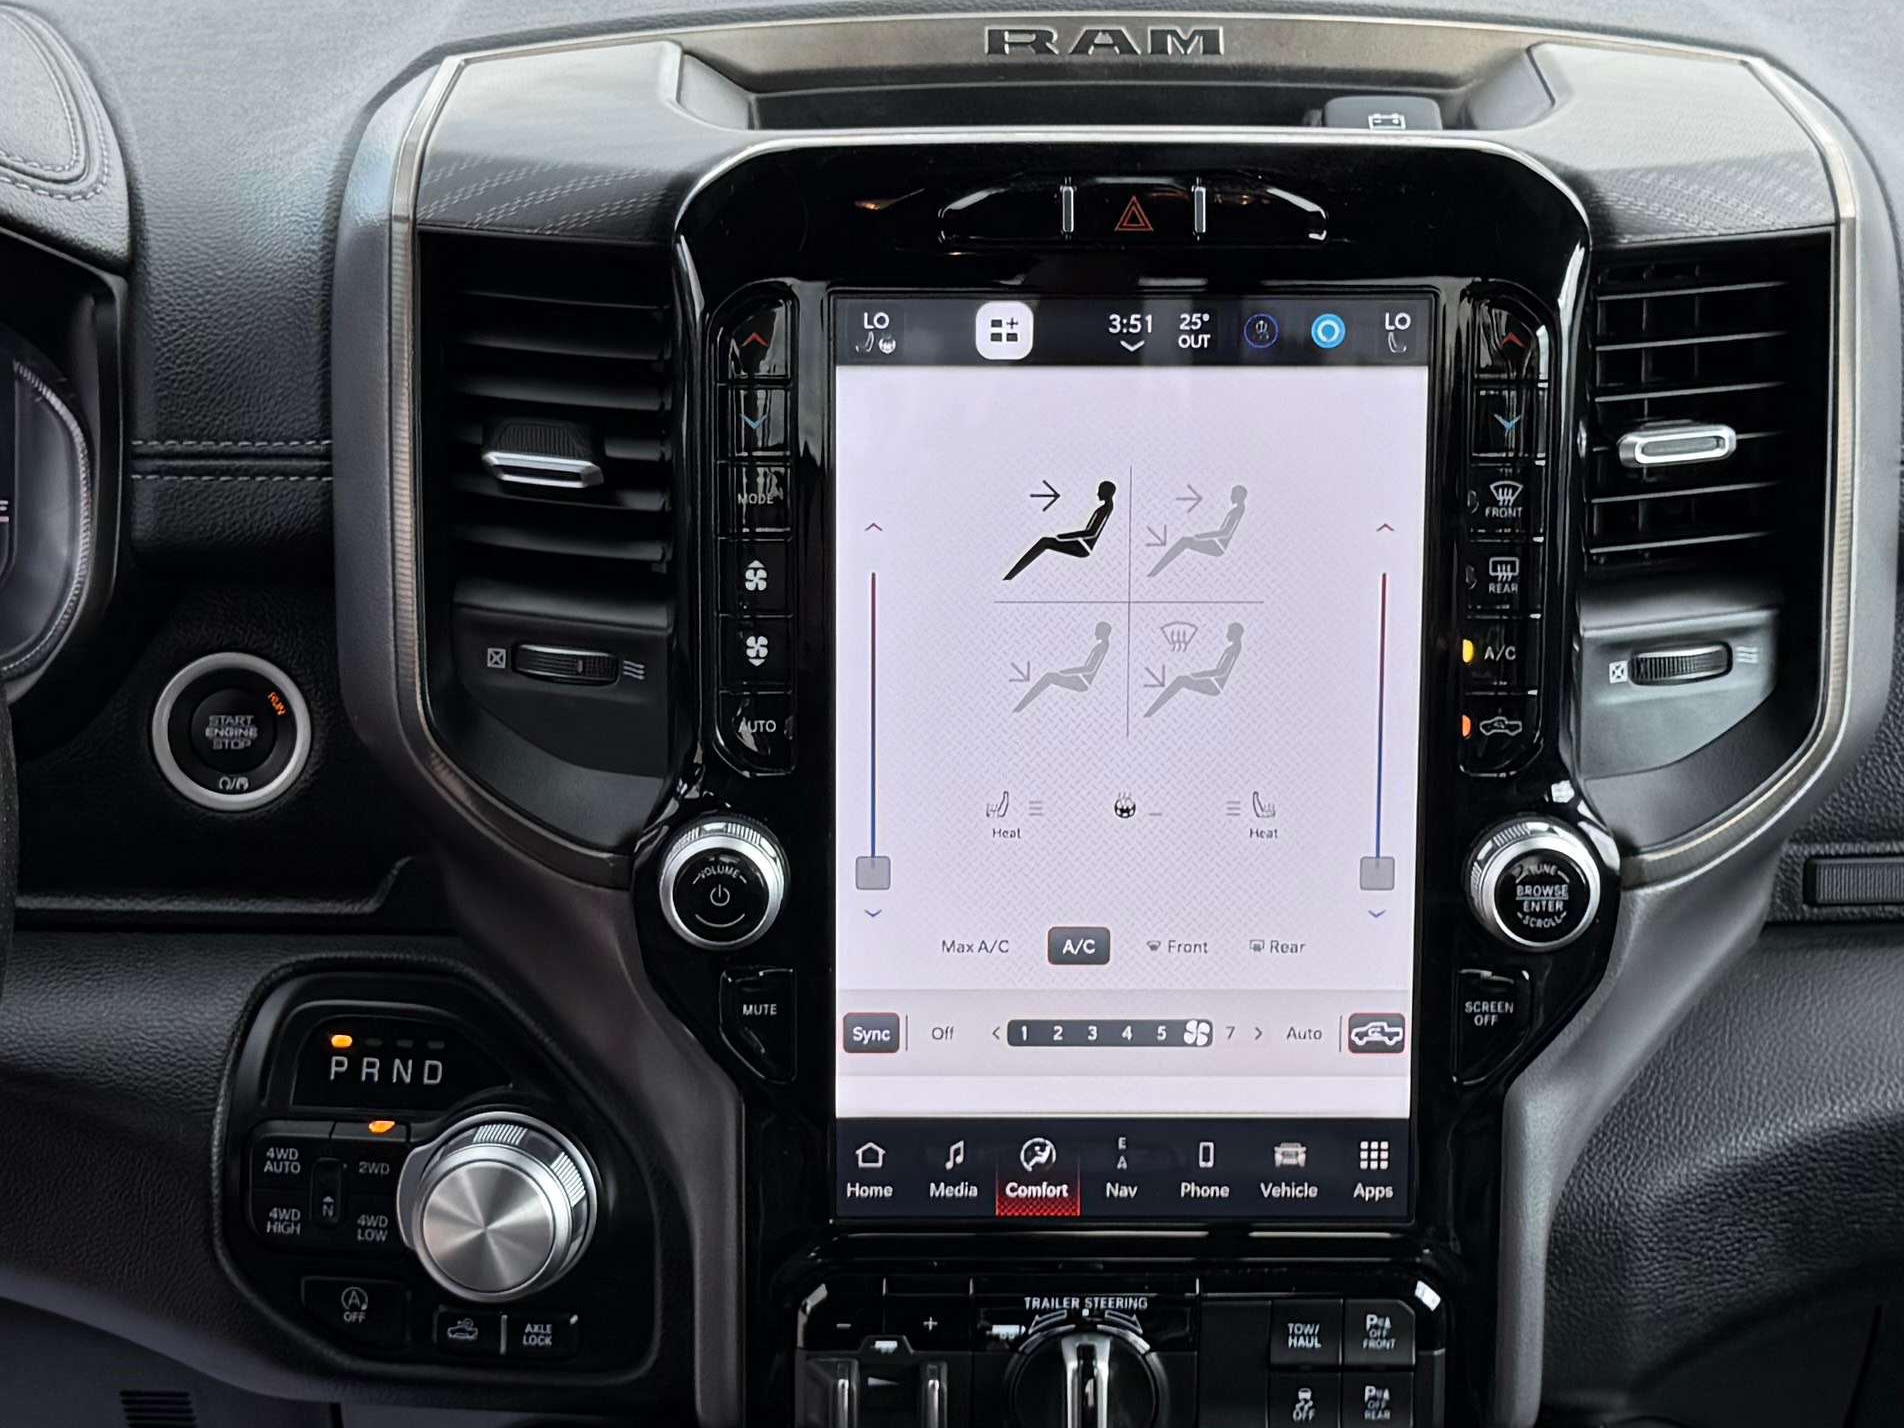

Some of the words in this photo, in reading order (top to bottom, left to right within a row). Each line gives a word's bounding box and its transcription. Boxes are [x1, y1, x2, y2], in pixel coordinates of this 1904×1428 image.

[984, 25, 1225, 56] RAM
[864, 312, 889, 329] LO
[1108, 314, 1153, 334] 3:51
[1179, 312, 1210, 330] 25°
[1384, 312, 1411, 330] LO
[1178, 334, 1211, 349] OUT
[737, 493, 774, 505] MODE
[1484, 506, 1523, 518] FRONT
[1489, 583, 1518, 594] REAR
[1484, 646, 1517, 661] A/C
[208, 715, 254, 726] START
[738, 720, 777, 733] AUTO
[204, 727, 258, 739] ENGINE
[213, 739, 252, 750] STOP
[992, 828, 1022, 839] Heat
[1249, 828, 1278, 839] Heat
[699, 864, 741, 879] VOLUME
[1516, 884, 1568, 897] BROWSE
[1523, 901, 1564, 912] ENTER
[1523, 914, 1562, 928] SCROLL
[942, 940, 974, 954] Max
[977, 939, 1010, 954] A/C
[1062, 939, 1096, 955] A/C
[1168, 939, 1209, 954] Front
[1269, 939, 1306, 954] Rear
[742, 1003, 778, 1016] MUTE
[1464, 1000, 1514, 1013] SCREEN
[1474, 1014, 1498, 1026] OFF
[852, 1025, 890, 1045] Sync
[931, 1025, 954, 1041] Off
[1021, 1026, 1029, 1041] 1
[1053, 1026, 1064, 1041] 2
[1087, 1026, 1098, 1041] 3
[1121, 1026, 1133, 1041] 4
[1157, 1026, 1167, 1041] 5
[1226, 1026, 1236, 1041] 7
[1286, 1025, 1323, 1041] Auto
[330, 1056, 348, 1081] P
[361, 1057, 380, 1082] R
[392, 1058, 413, 1084] N
[423, 1060, 443, 1085] D
[266, 1147, 299, 1161] 4WD
[264, 1161, 301, 1174] AUTO
[358, 1161, 391, 1175] 2WD
[846, 1182, 893, 1199] Home
[929, 1182, 978, 1199] Media
[1005, 1181, 1069, 1199] Comfort
[1106, 1182, 1138, 1199] Nav
[1180, 1182, 1230, 1199] Phone
[1260, 1182, 1319, 1199] Vehicle
[1353, 1182, 1394, 1201] Apps
[269, 1207, 302, 1221] 4WD
[322, 1204, 334, 1217] N
[266, 1221, 301, 1235] HIGH
[356, 1214, 389, 1228] 4WD
[357, 1228, 388, 1242] LOW
[1024, 1296, 1080, 1309] TRAILER
[1084, 1296, 1148, 1310] STEERING
[343, 1312, 366, 1323] OFF
[524, 1323, 552, 1334] AXLE
[522, 1334, 553, 1346] LOCK
[1288, 1336, 1322, 1349] HAUL
[1362, 1338, 1396, 1350] FRONT
[1292, 1408, 1316, 1422] OFF
